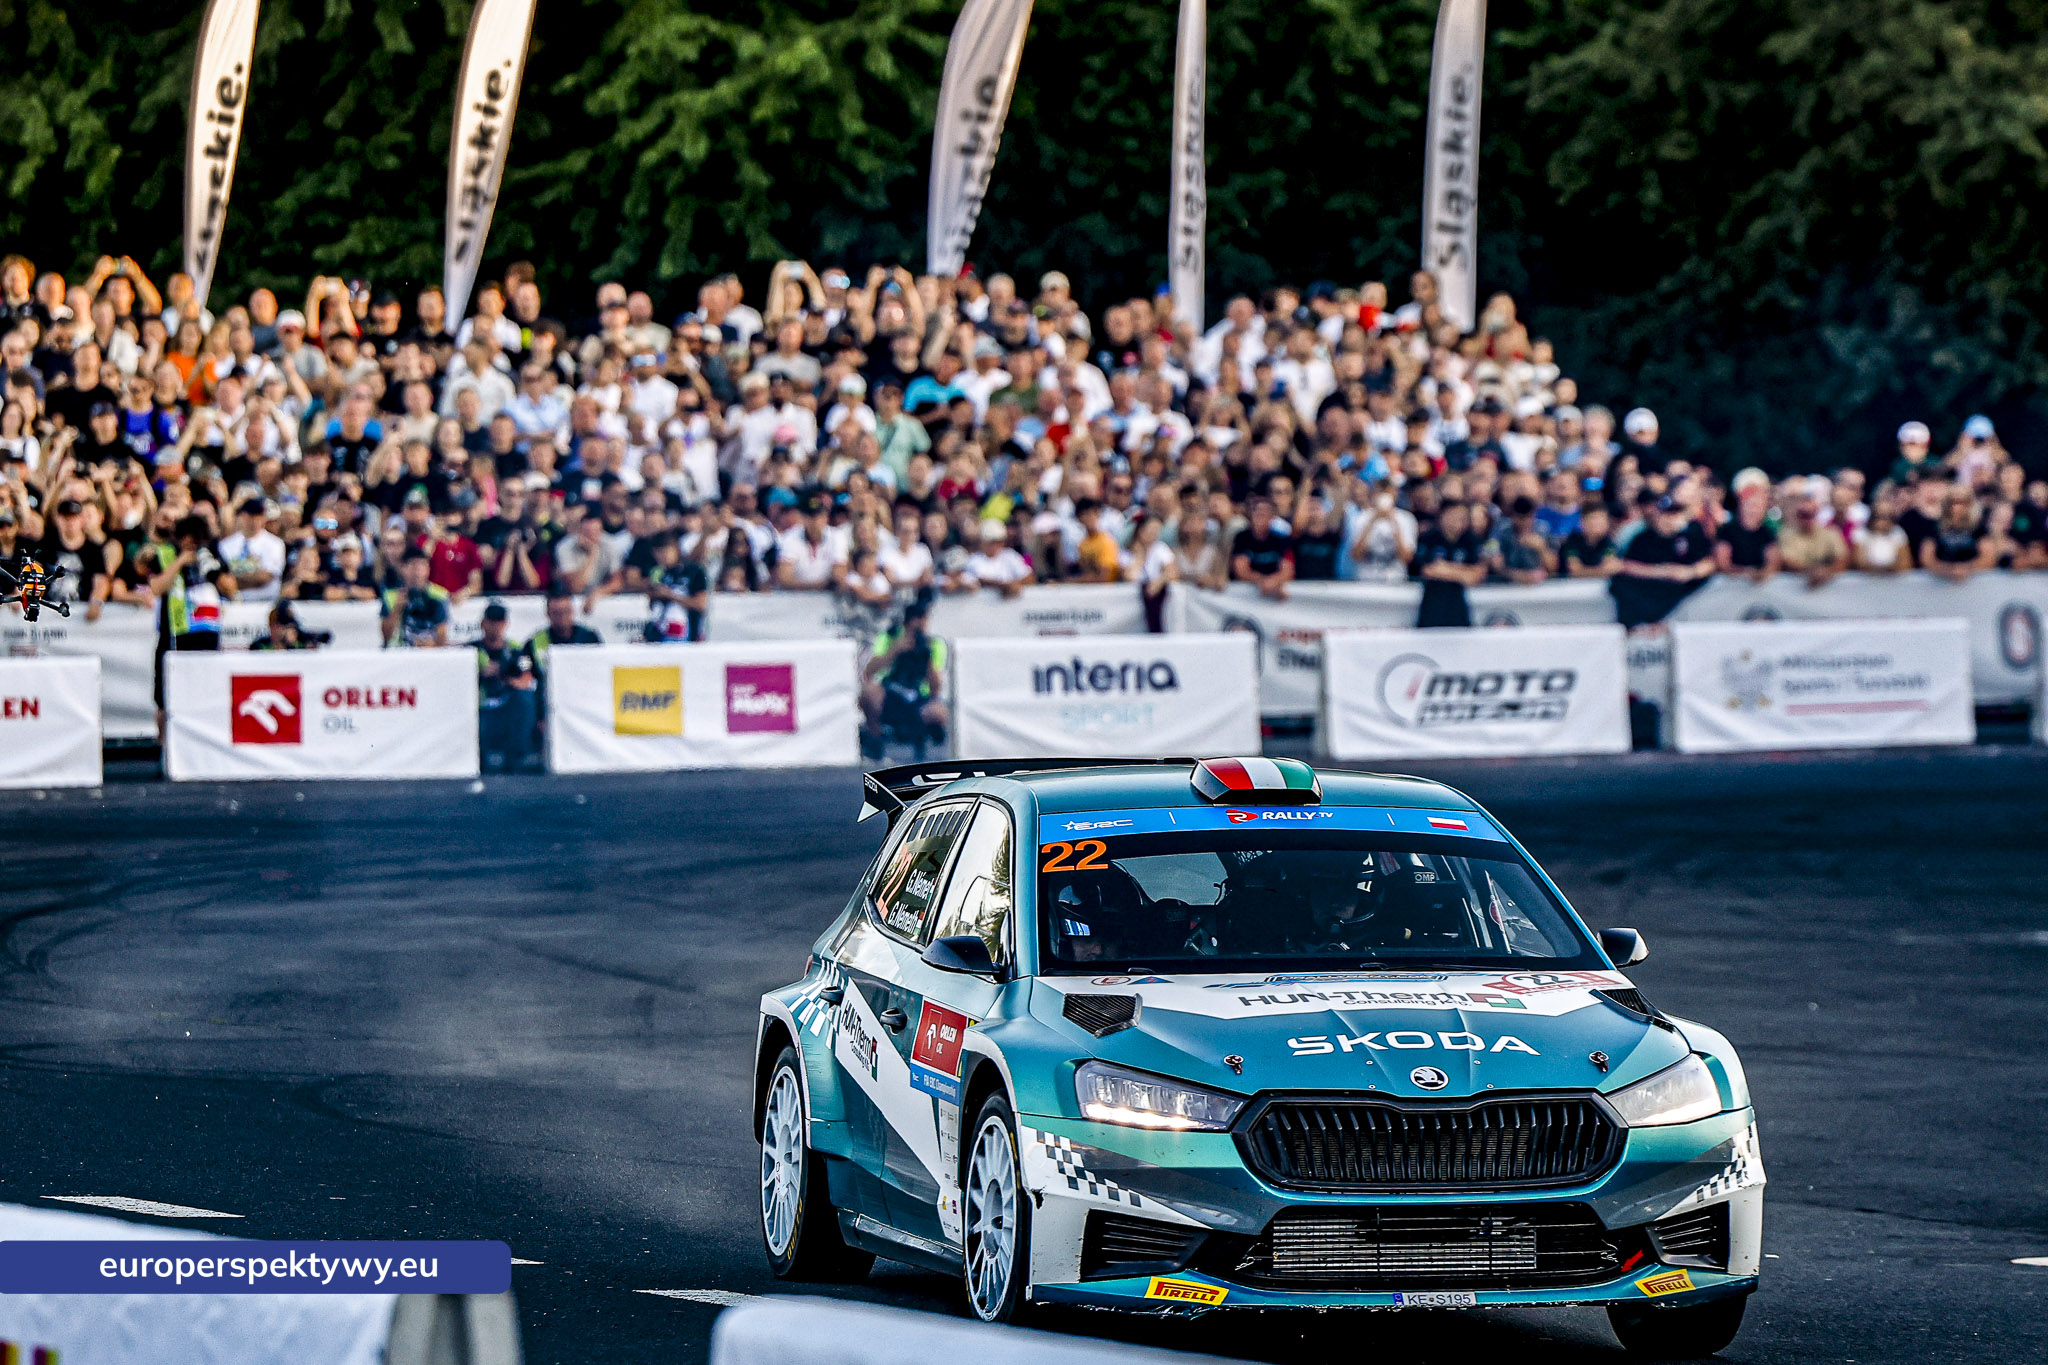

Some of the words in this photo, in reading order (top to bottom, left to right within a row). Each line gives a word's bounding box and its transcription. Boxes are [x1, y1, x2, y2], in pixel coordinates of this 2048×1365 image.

[323, 686, 417, 709] ORLEN
[0, 697, 40, 719] EN
[324, 717, 356, 733] OIL
[1041, 840, 1109, 873] 22
[1513, 974, 1573, 987] 22
[1238, 991, 1468, 1007] HUN-Therm
[1153, 1281, 1220, 1301] PIRELLI
[1642, 1274, 1690, 1294] PIRELLI
